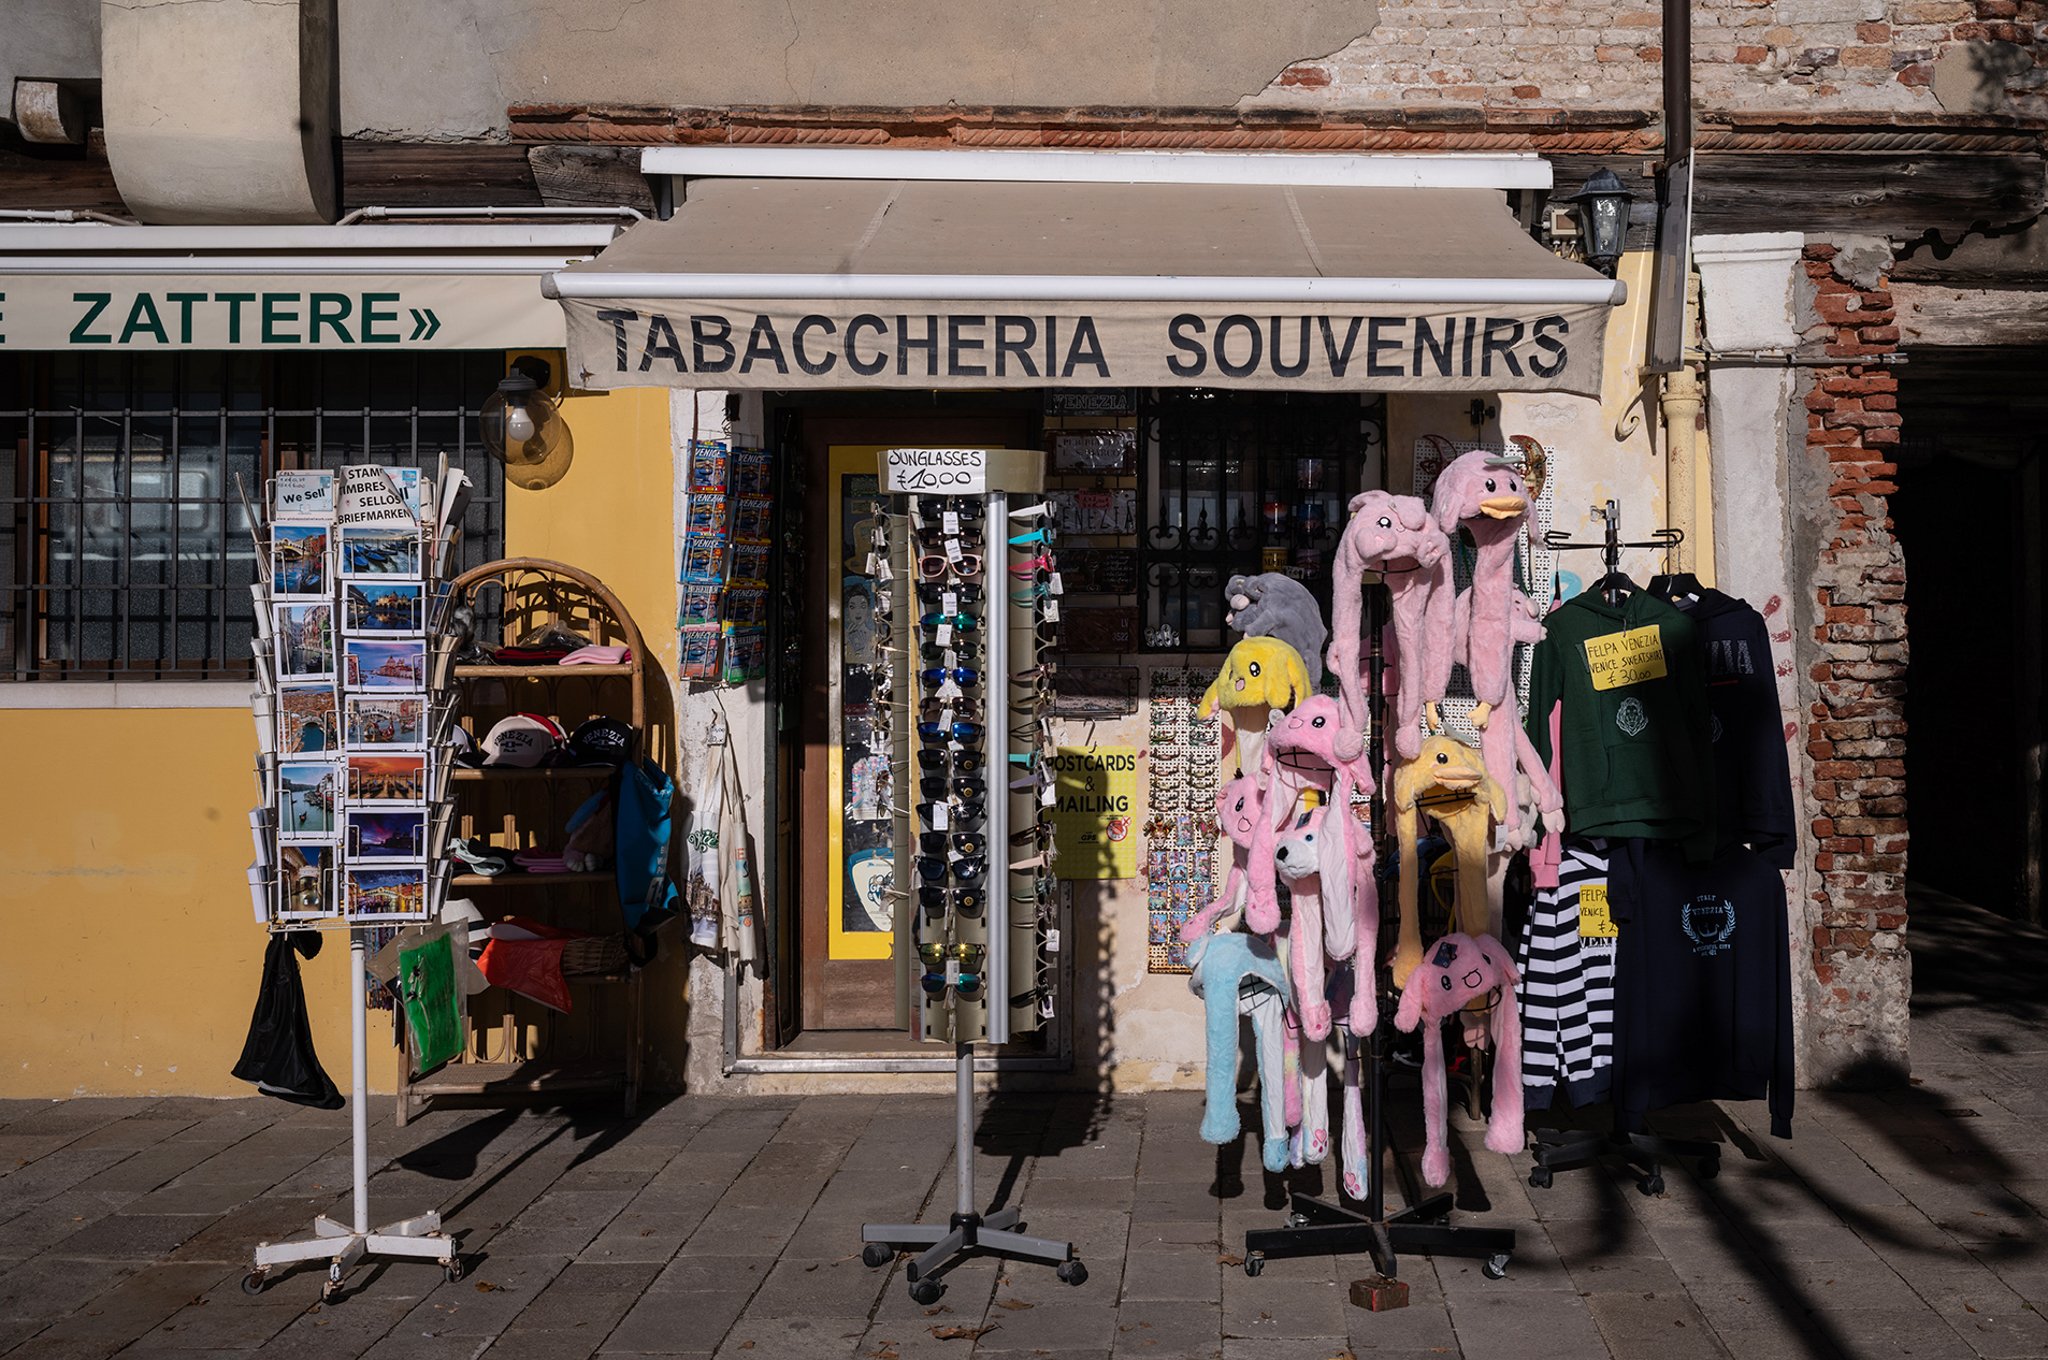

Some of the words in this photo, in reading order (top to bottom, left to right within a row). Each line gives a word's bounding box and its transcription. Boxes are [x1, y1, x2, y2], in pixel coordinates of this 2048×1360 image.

[597, 309, 1111, 378] TABACCHERIA
[1166, 313, 1570, 379] SOUVENIRS
[1052, 394, 1128, 409] VENEZIA
[694, 448, 722, 457] VENICE
[738, 454, 765, 462] VENICE
[889, 449, 982, 467] SUNGLASSES
[283, 494, 303, 504] We
[304, 488, 325, 500] Sell
[360, 495, 402, 507] SELLOS
[693, 494, 723, 502] VENEZIA
[738, 499, 770, 508] VENEZIA
[338, 508, 411, 525] BRIEFMARKEN
[1063, 506, 1134, 529] ENEZIA
[1588, 642, 1619, 658] FELPA
[1620, 635, 1659, 651] VENEZIA
[1589, 659, 1619, 674] VENICE
[1621, 649, 1664, 668] SWEATSHIRT
[494, 730, 533, 747] VENEZIA
[583, 729, 625, 747] VENEZIA
[1046, 755, 1136, 772] POSTCARDS
[1085, 776, 1096, 792] &
[1051, 795, 1129, 812] MAILING
[1581, 889, 1608, 902] FELPA
[1580, 907, 1605, 917] VENICE
[1692, 906, 1724, 915] VENEZIA
